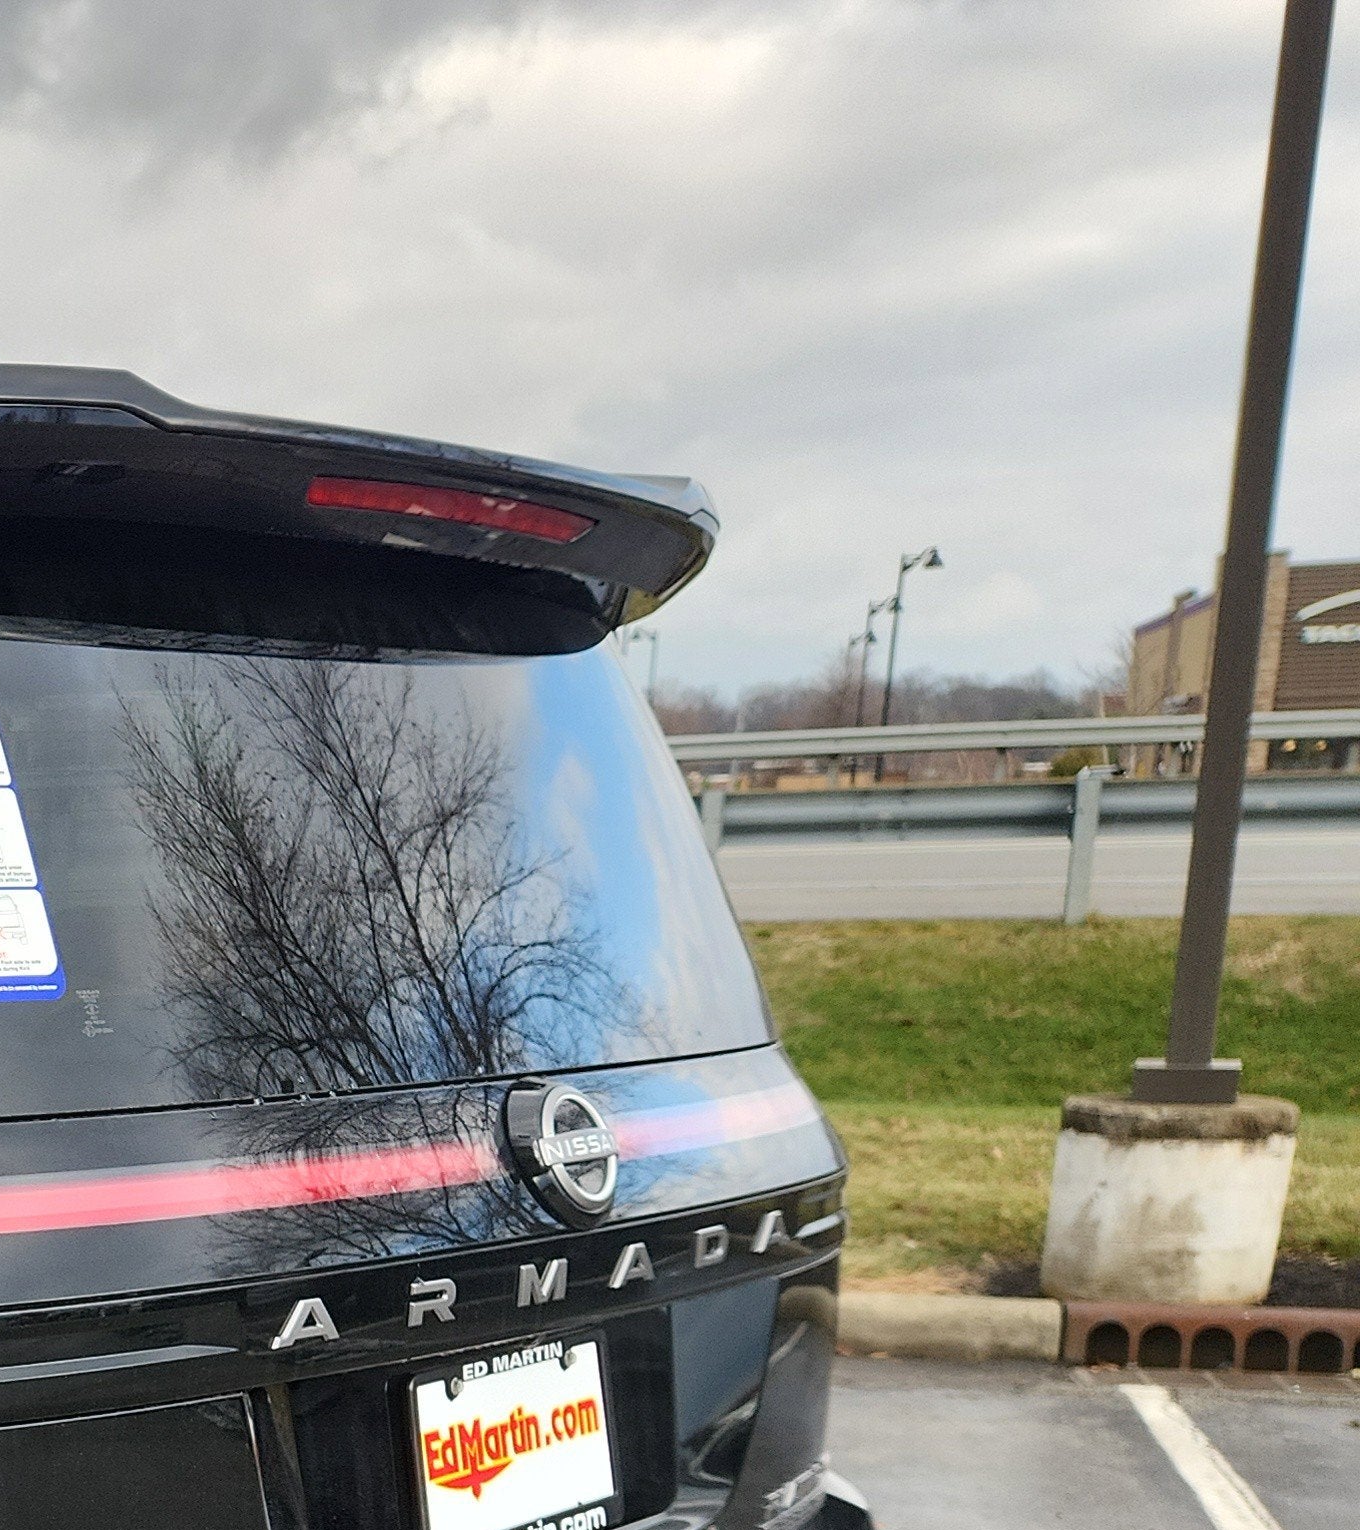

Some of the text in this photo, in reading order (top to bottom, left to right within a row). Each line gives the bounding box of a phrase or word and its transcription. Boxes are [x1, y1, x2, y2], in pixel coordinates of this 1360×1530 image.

[543, 1132, 614, 1160] NISSA
[269, 1208, 791, 1351] ARMADA
[462, 1341, 564, 1381] ED MARTIN
[423, 1397, 600, 1483] EdMartin.com
